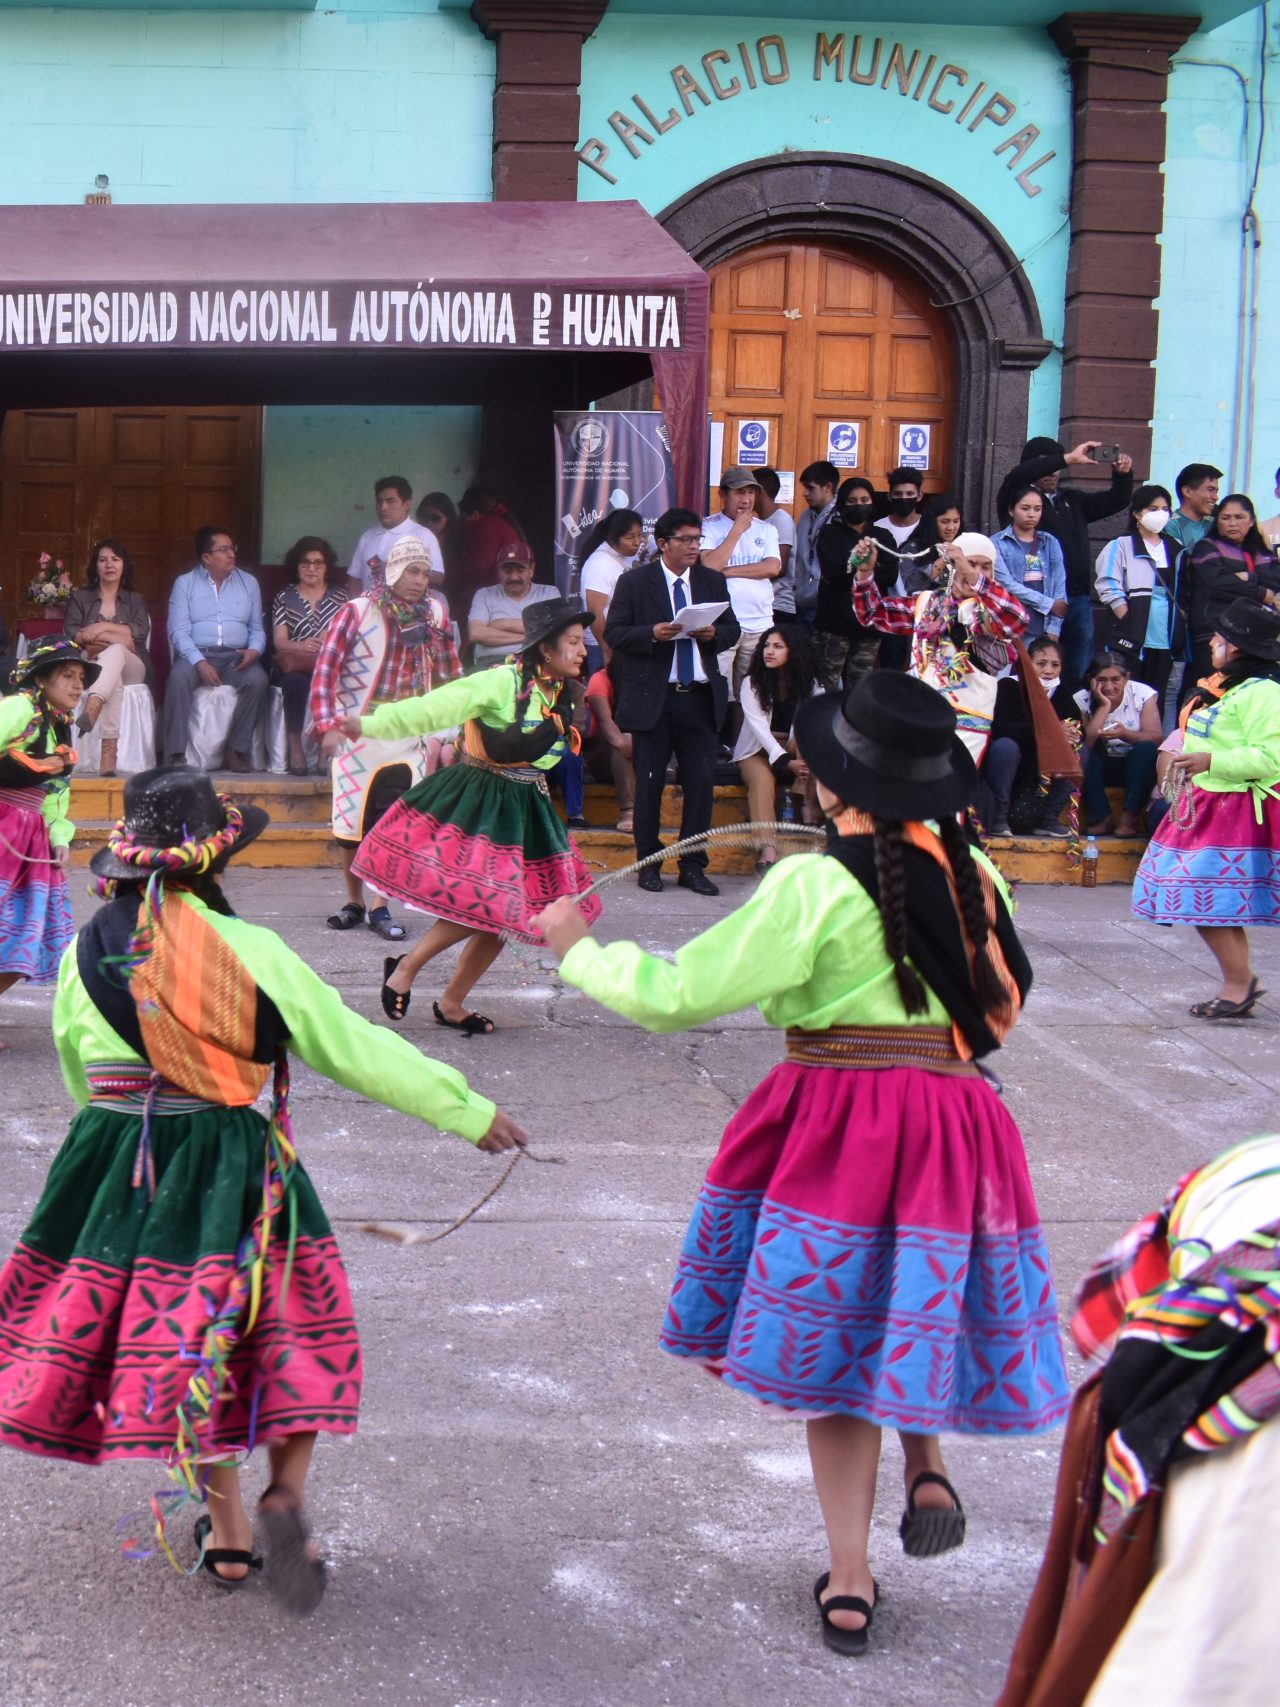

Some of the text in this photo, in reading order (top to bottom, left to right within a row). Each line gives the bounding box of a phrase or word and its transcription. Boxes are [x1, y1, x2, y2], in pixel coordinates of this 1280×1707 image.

[577, 32, 1057, 199] PALACIO MUNICIPAL
[189, 290, 337, 343] NACIONAL
[350, 281, 516, 344] AUTÓNOMA
[533, 292, 552, 346] DE
[563, 293, 681, 348] HUANTA
